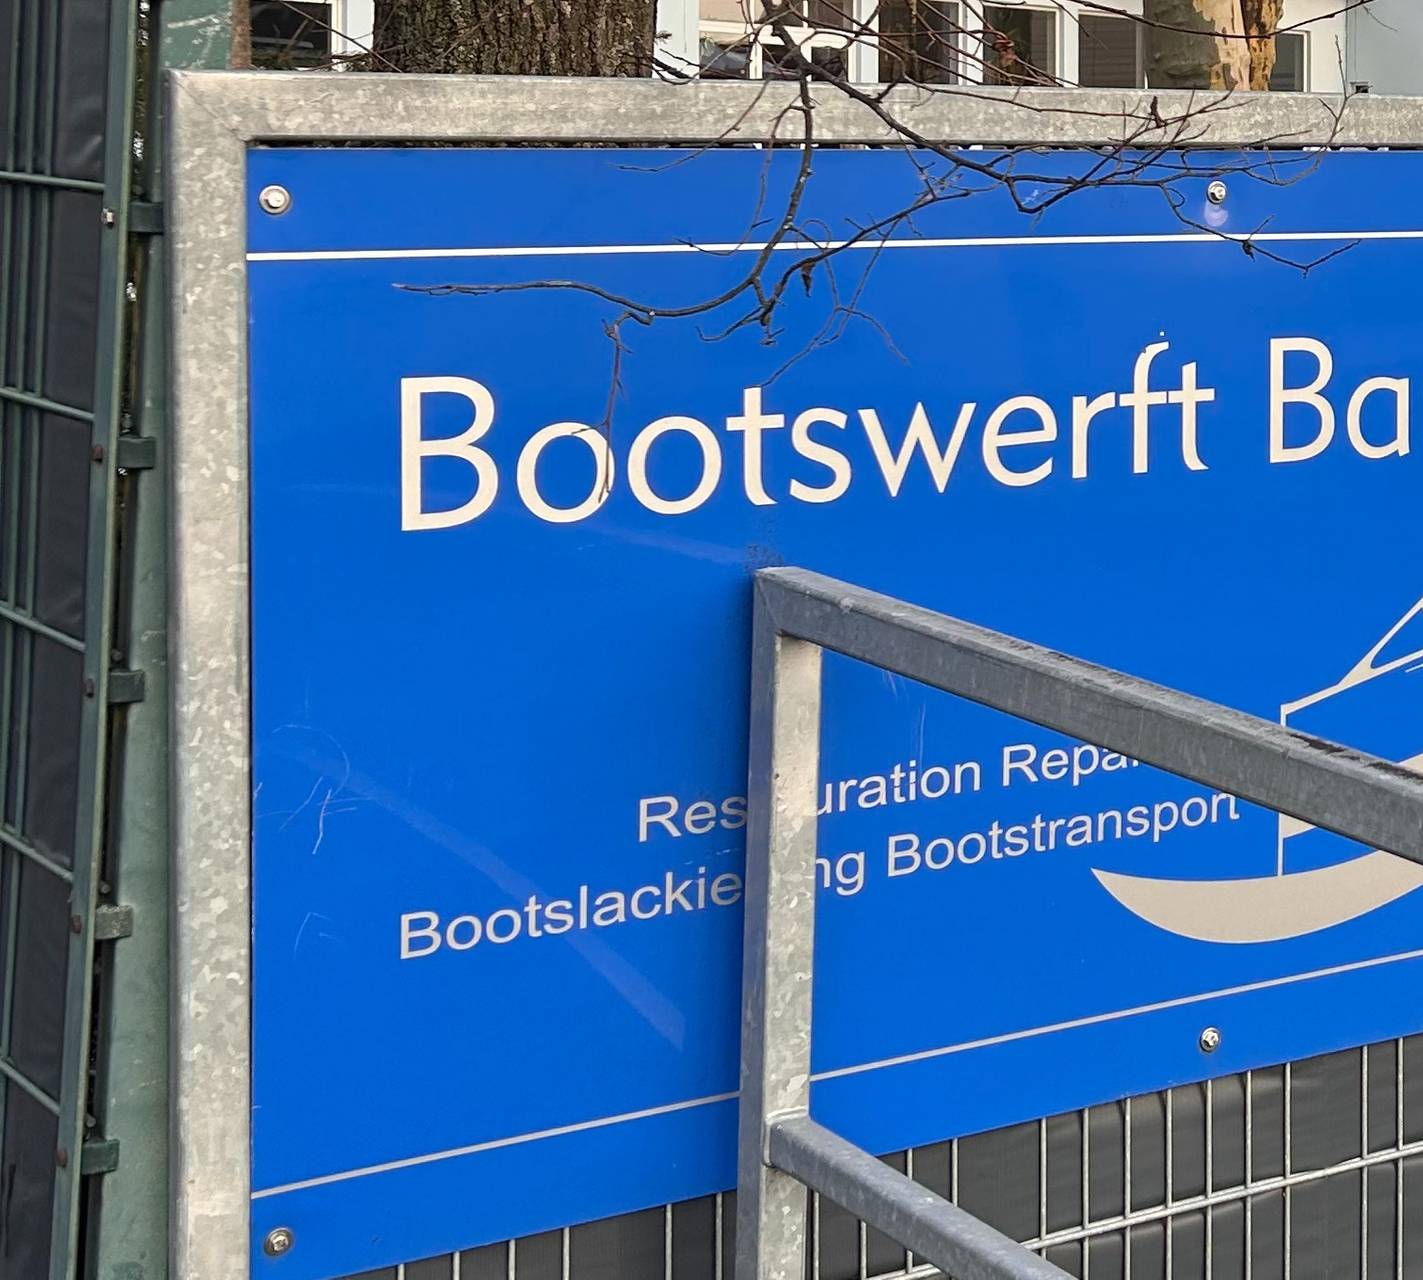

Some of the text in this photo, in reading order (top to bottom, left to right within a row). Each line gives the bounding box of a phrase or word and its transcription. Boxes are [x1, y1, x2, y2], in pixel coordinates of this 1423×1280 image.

[400, 339, 1216, 532] Bootswerft
[400, 791, 1241, 959] Bootslackieng Bootstransport
[638, 760, 982, 844] Resuration
